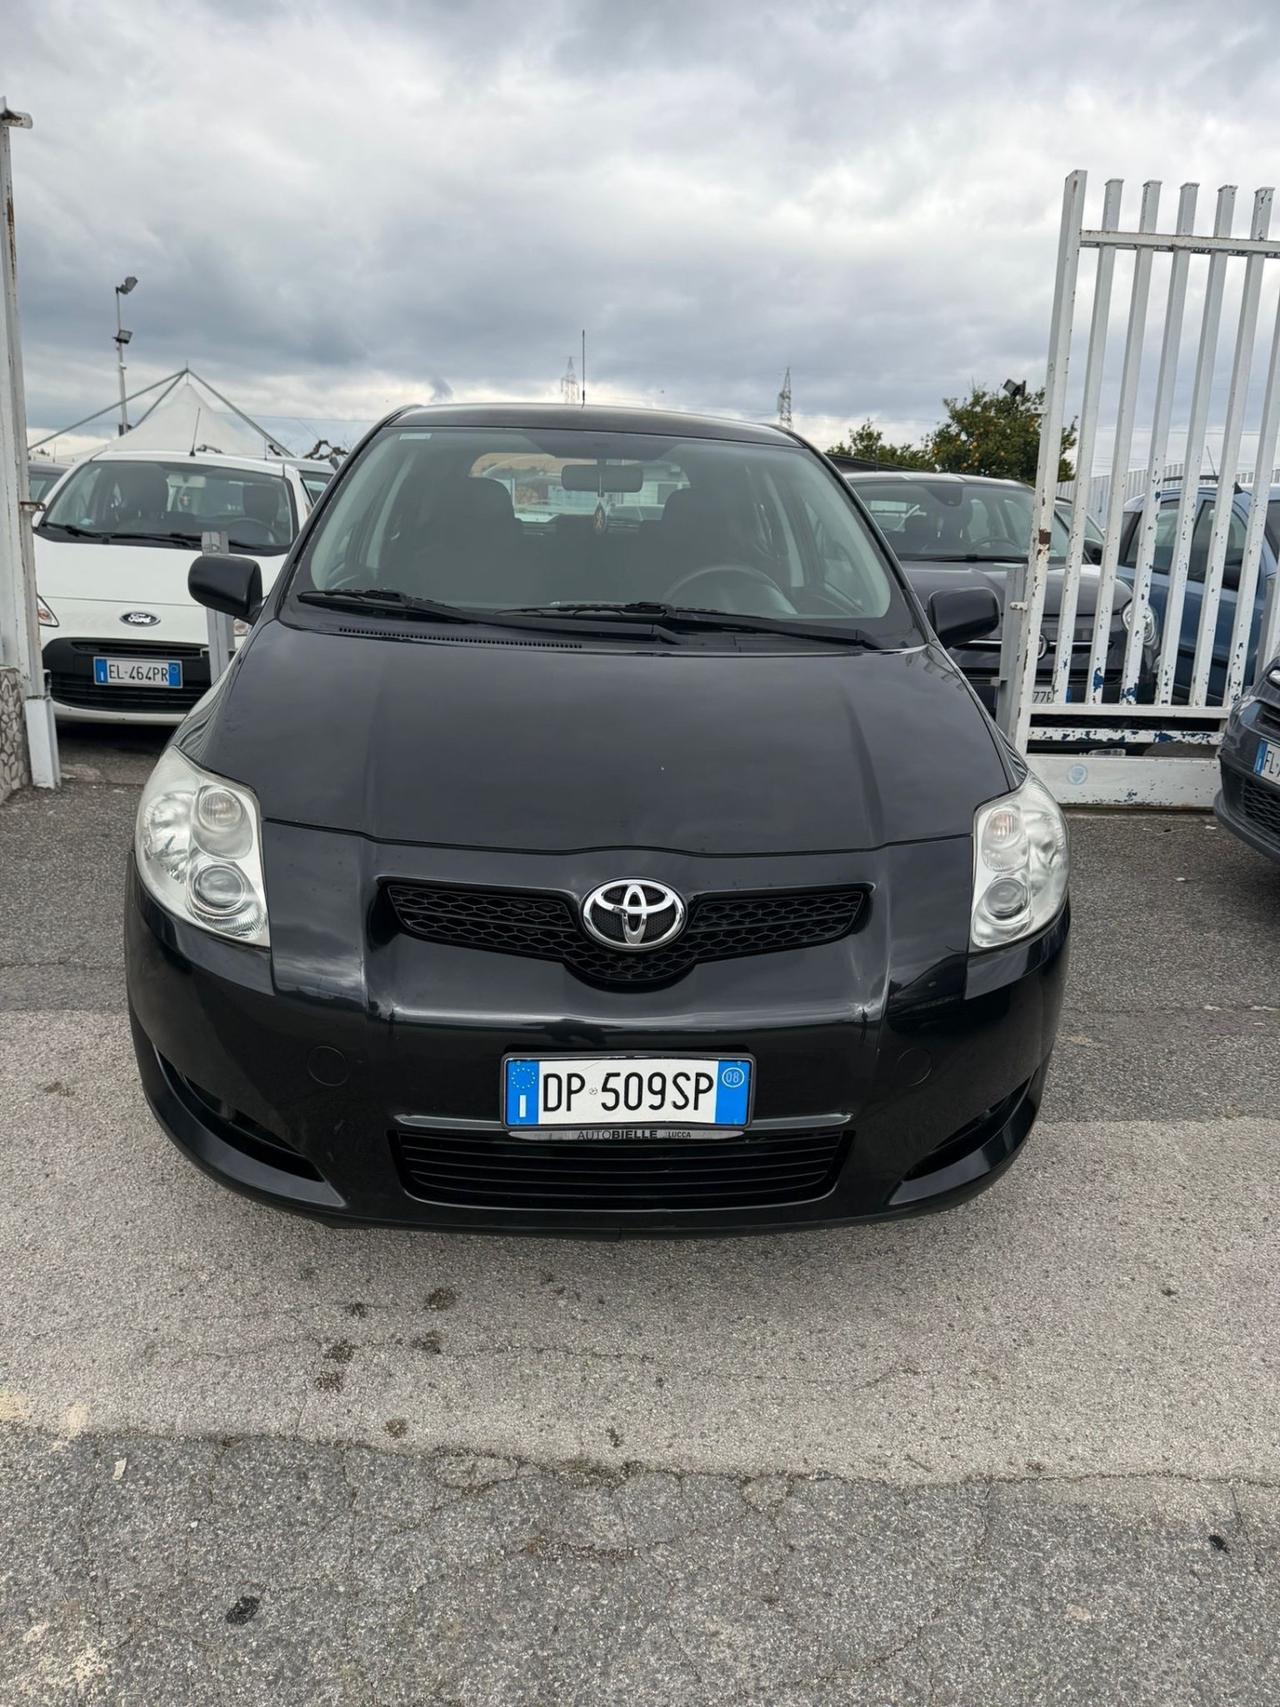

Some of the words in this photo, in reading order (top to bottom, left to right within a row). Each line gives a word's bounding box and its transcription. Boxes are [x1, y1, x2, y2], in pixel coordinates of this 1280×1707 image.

[109, 664, 124, 680] EL
[128, 665, 169, 682] 464PR
[725, 1071, 740, 1083] 08
[543, 1073, 586, 1112] DP
[601, 1072, 714, 1112] 509SP
[577, 1129, 658, 1140] AUTOBIELLE
